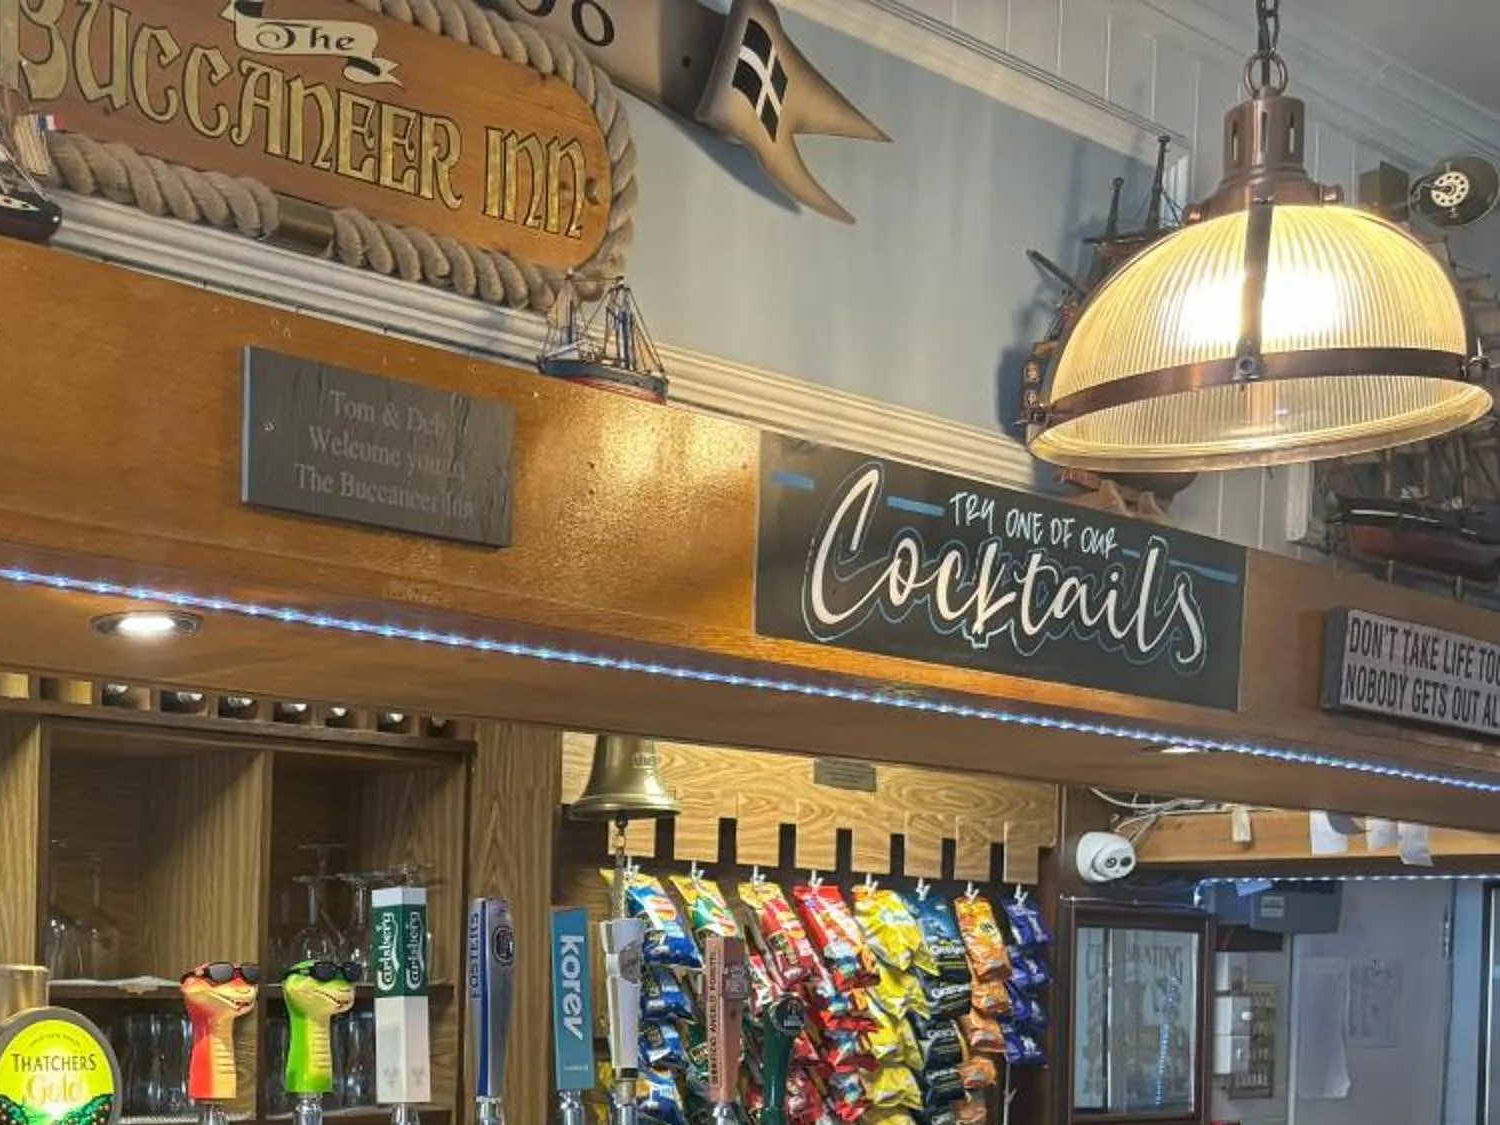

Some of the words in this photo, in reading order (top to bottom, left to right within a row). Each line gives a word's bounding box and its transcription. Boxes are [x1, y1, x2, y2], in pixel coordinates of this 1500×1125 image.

[255, 20, 356, 53] The
[484, 124, 590, 241] INN
[329, 389, 376, 424] Tom
[381, 401, 399, 430] &
[308, 424, 401, 468] Welcome
[293, 463, 334, 495] The
[339, 471, 440, 514] Buccaneer
[949, 491, 996, 536] TRY
[1004, 507, 1044, 544] ONE
[1050, 517, 1077, 548] OF
[1080, 526, 1119, 559] OUR
[810, 468, 1204, 663] Cocktails
[1349, 617, 1399, 663] DON'T
[1401, 628, 1440, 672] TAKE
[1443, 639, 1475, 679] LIFE
[1345, 663, 1409, 711] NOBODY
[1411, 676, 1449, 719] GETS
[1451, 685, 1481, 724] OUT
[1483, 693, 1500, 728] AL
[376, 911, 400, 992] Carlsberg
[405, 910, 422, 992] Carlsberg
[559, 933, 587, 1042] korev
[11, 1052, 98, 1073] THATCHERS
